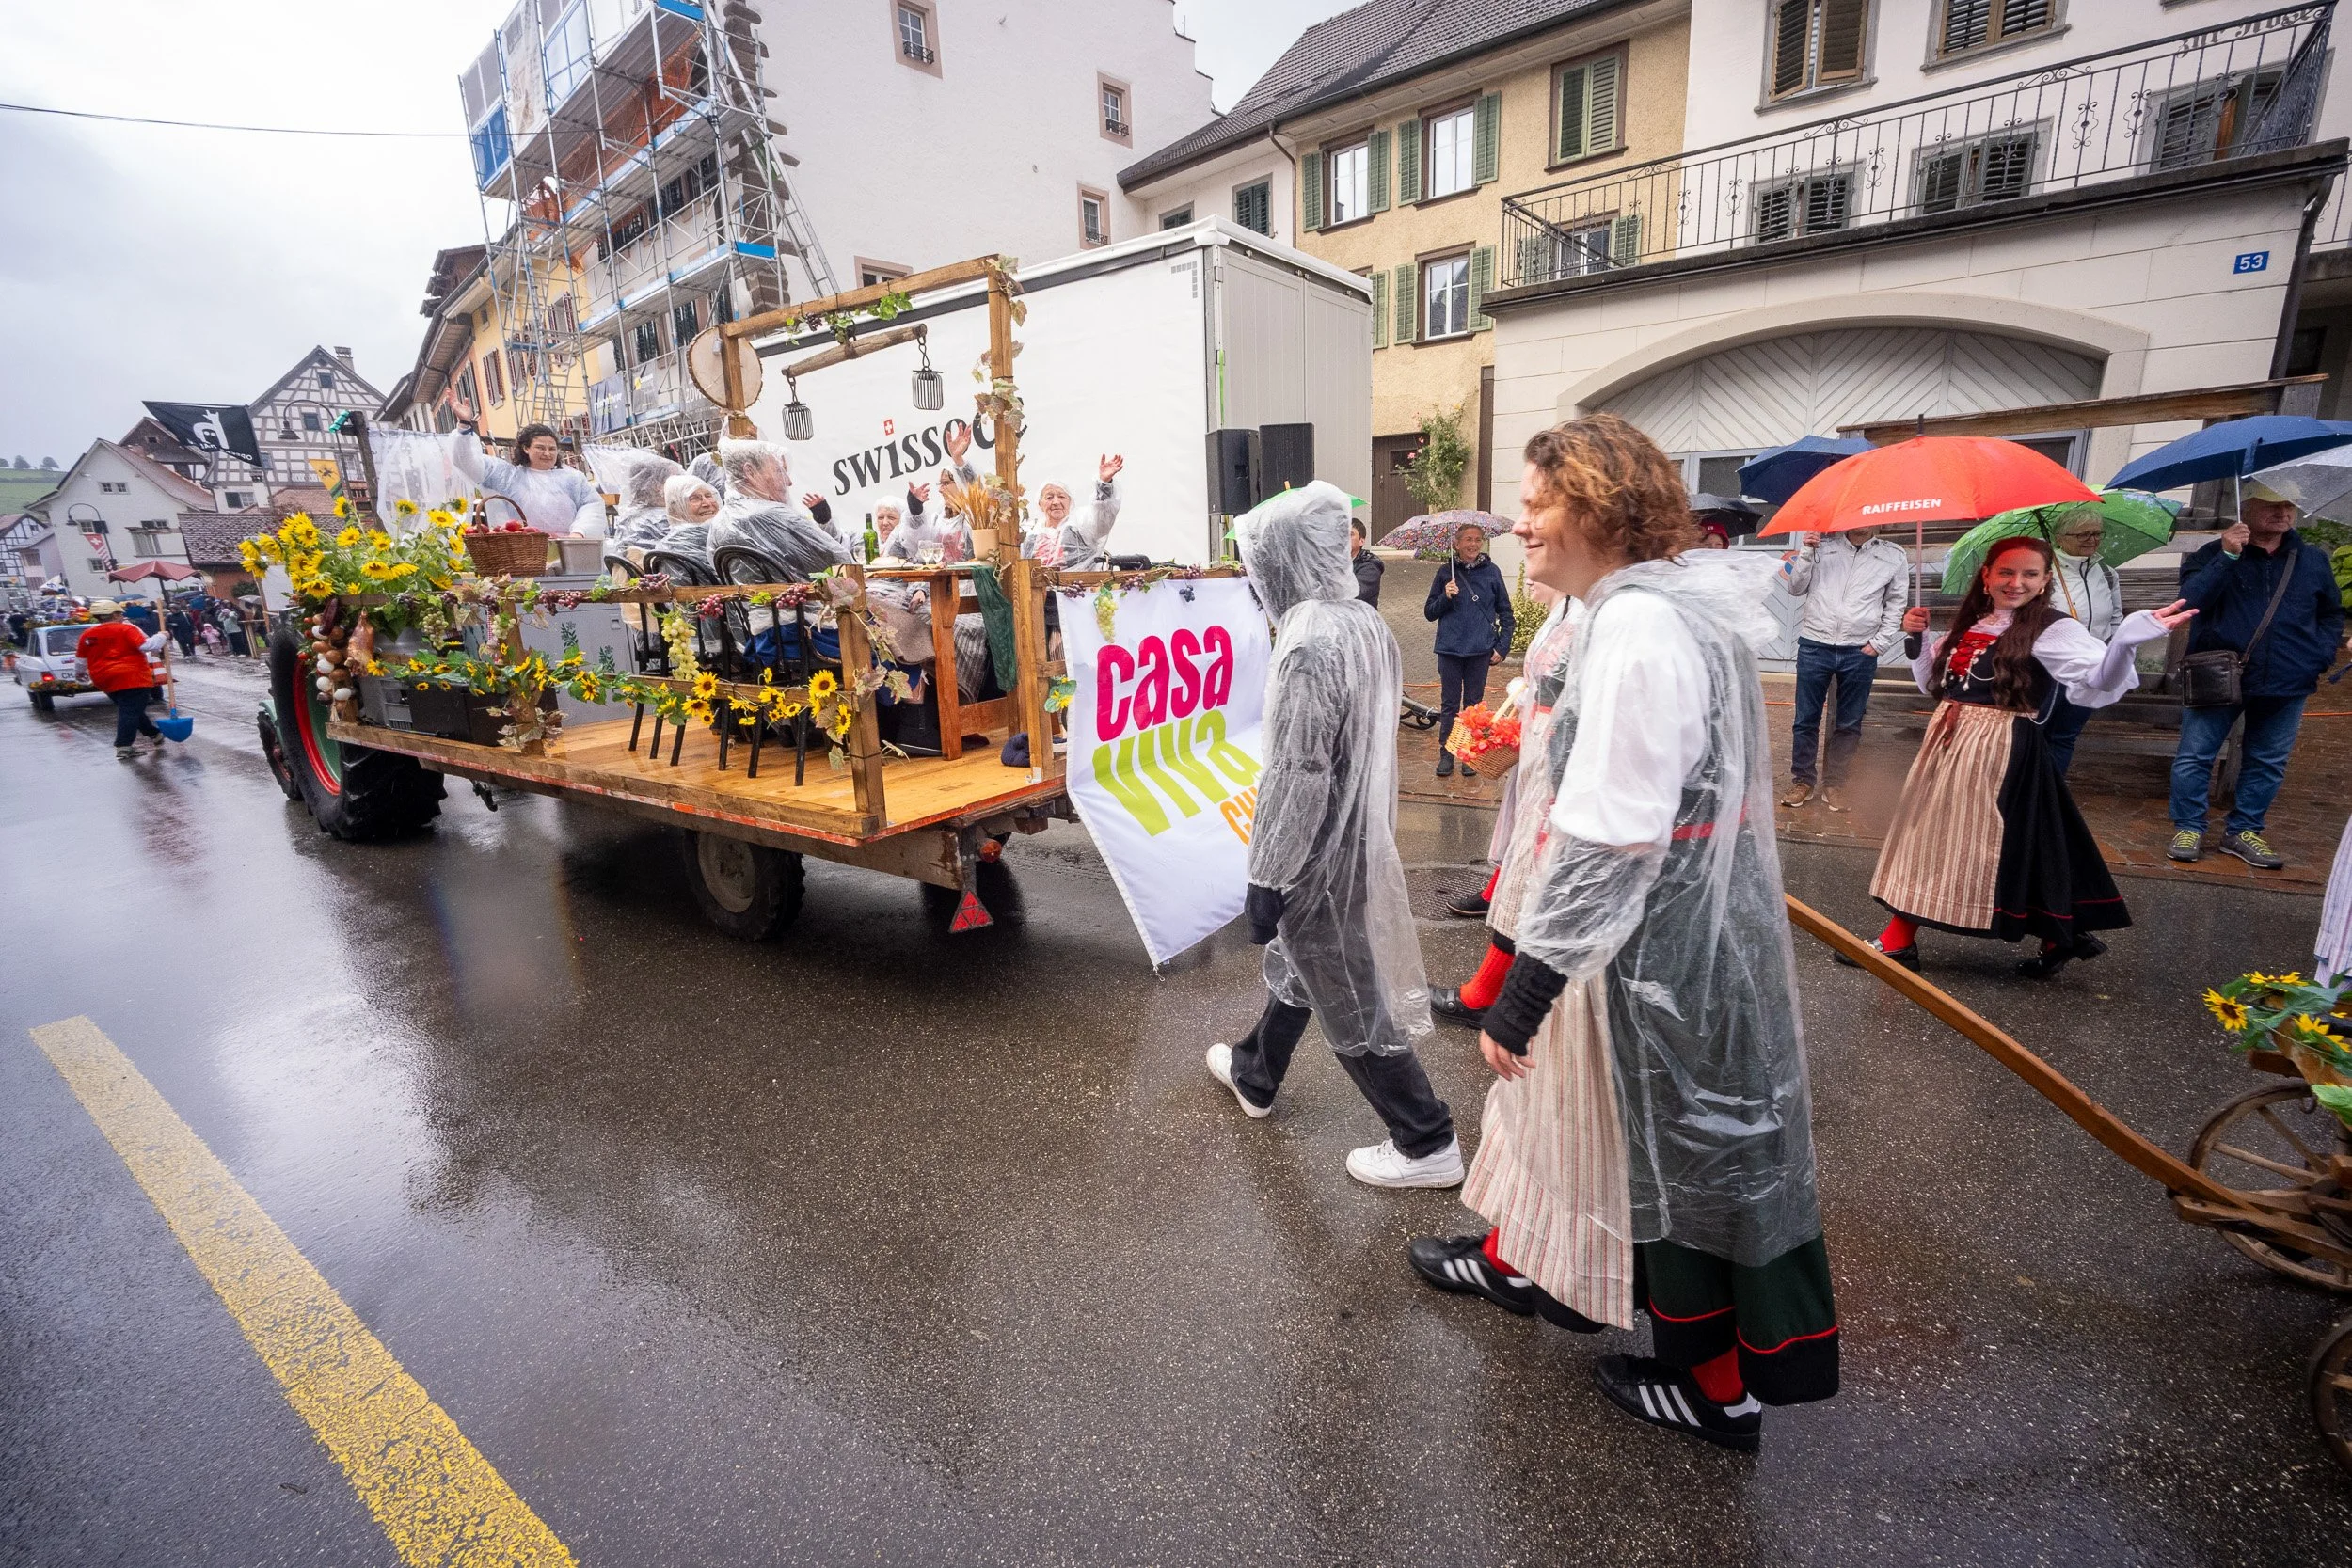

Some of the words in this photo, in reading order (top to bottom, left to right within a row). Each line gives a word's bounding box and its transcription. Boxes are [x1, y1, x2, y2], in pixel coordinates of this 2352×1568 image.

[2239, 254, 2264, 271] 53
[1862, 498, 1942, 515] RAIFFEISEN
[1097, 626, 1233, 742] casa
